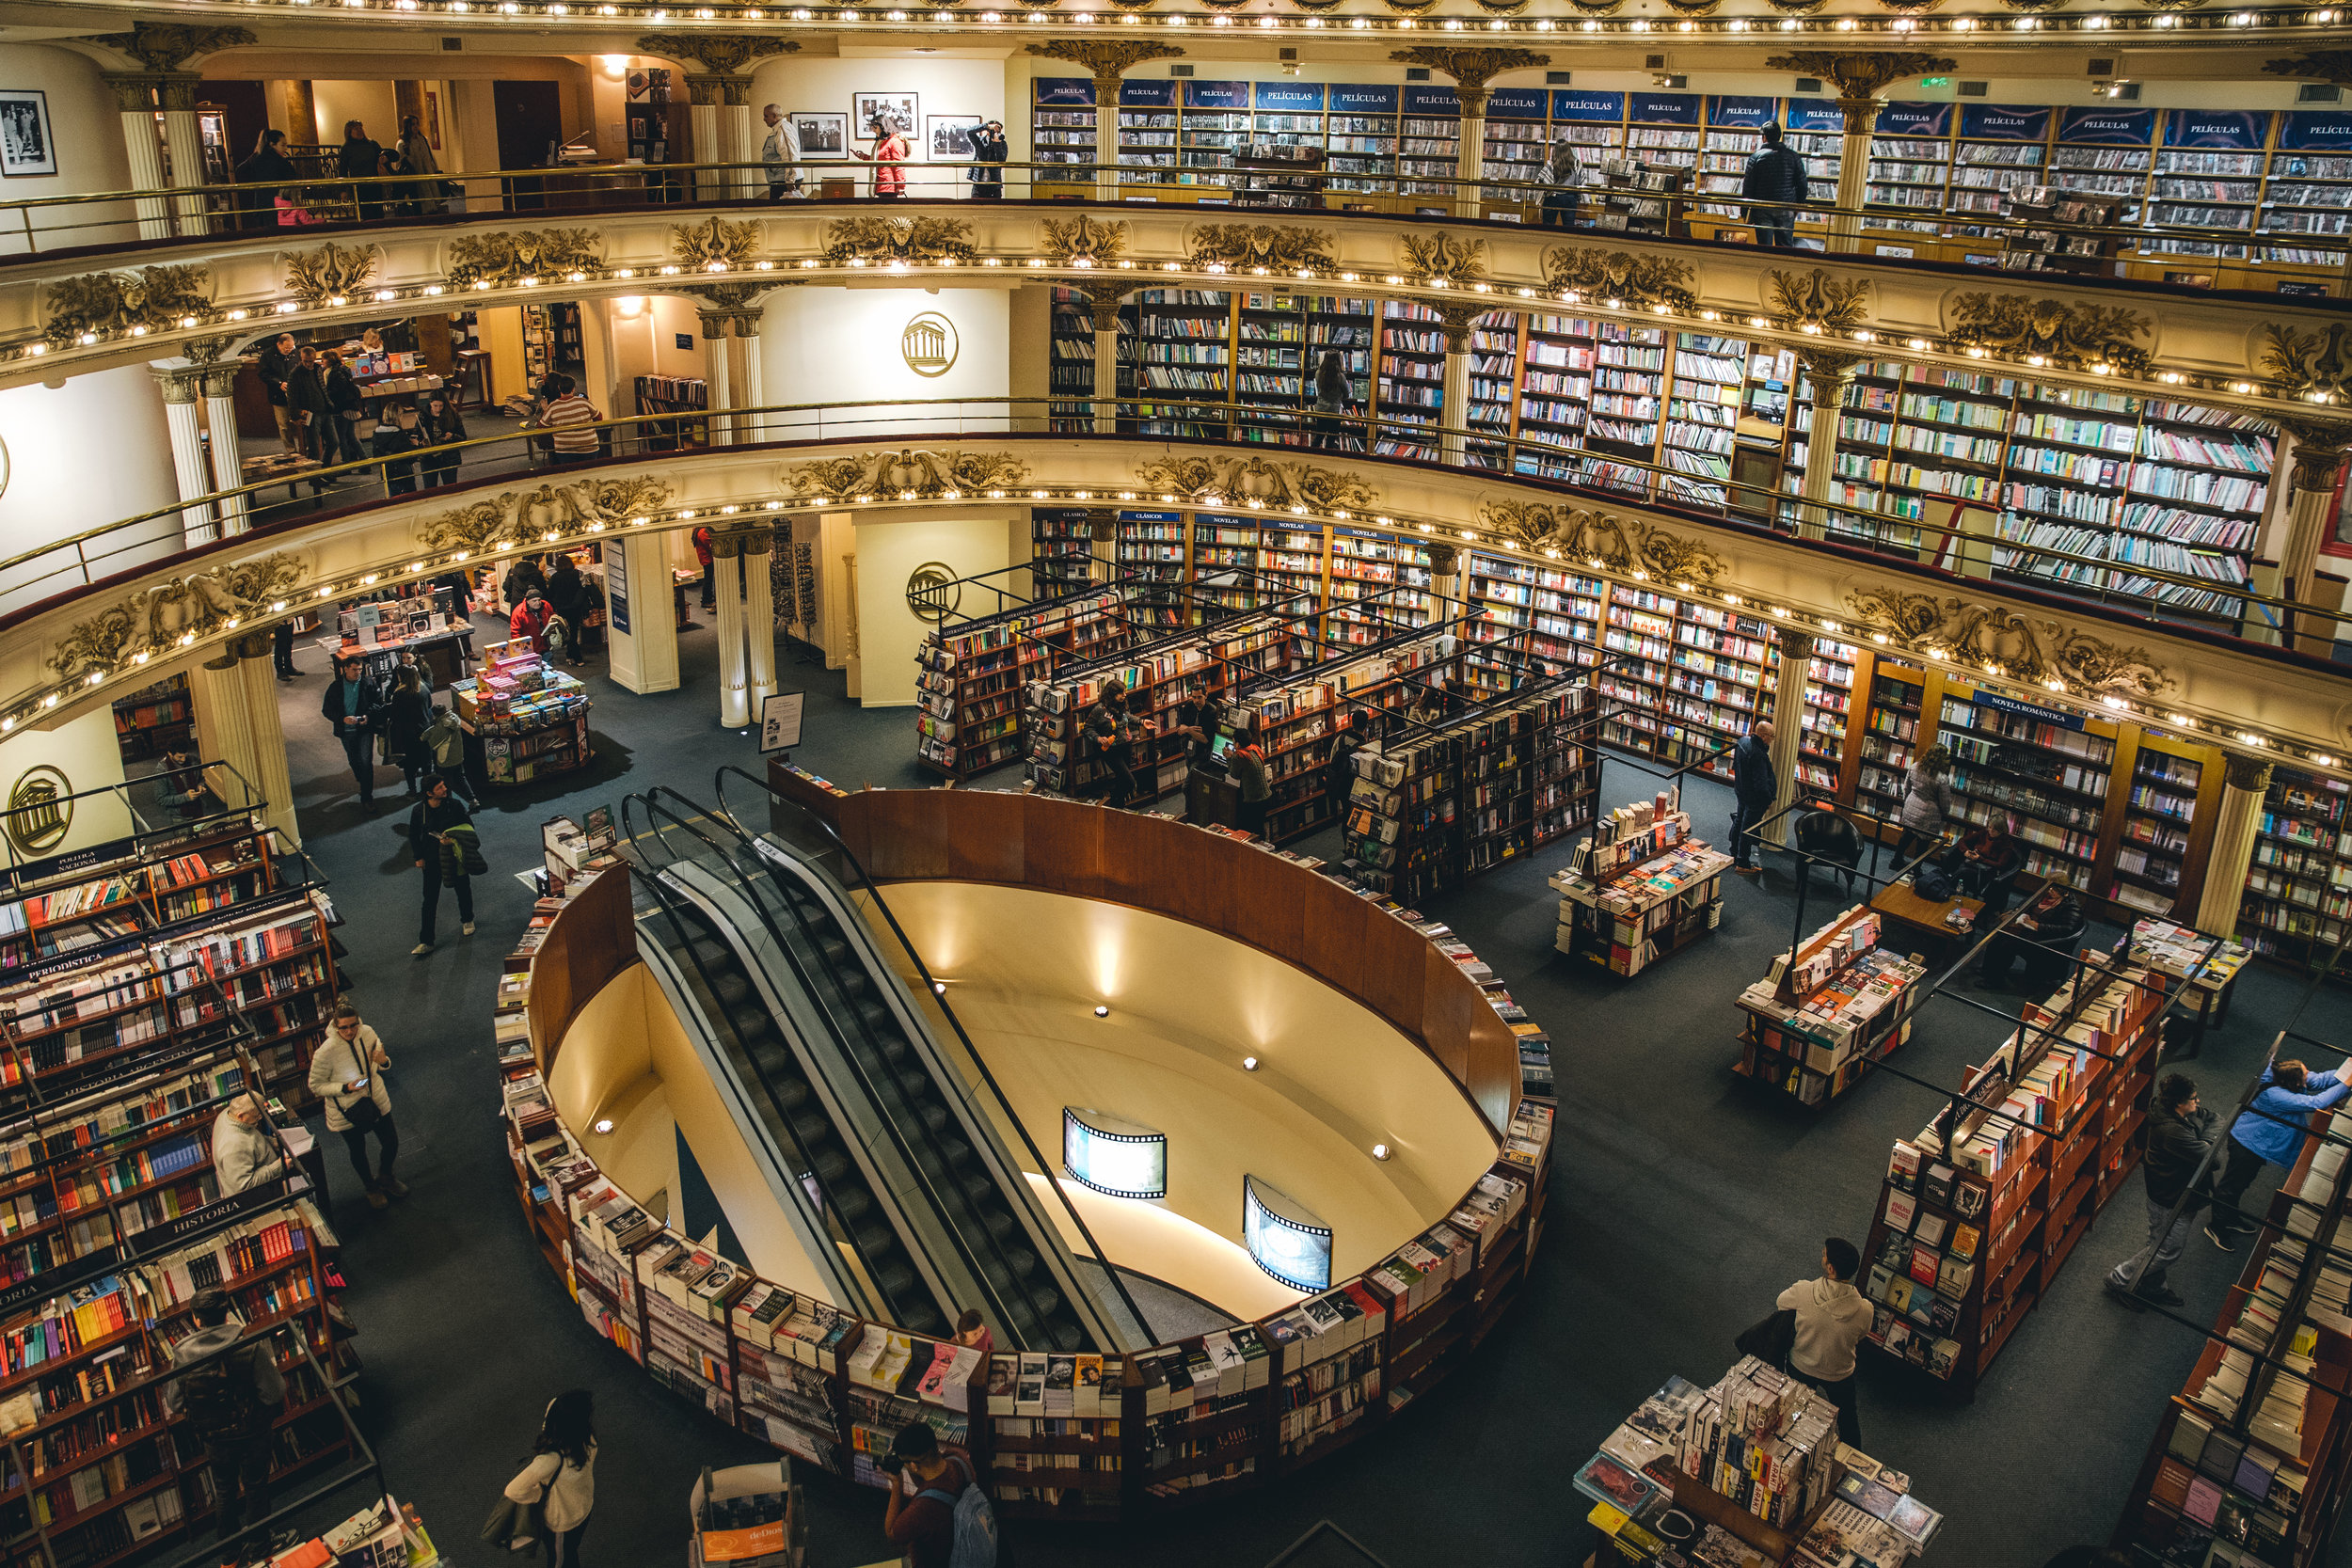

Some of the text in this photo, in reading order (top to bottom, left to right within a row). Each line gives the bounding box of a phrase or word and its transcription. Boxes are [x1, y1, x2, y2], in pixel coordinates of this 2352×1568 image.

[1266, 91, 1312, 101] PELÍCULAS
[1342, 93, 1387, 103] PELÍCULAS
[1416, 94, 1461, 104] PELÍCULAS
[1489, 98, 1536, 107] PELÍCULAS
[1565, 101, 1613, 110] PELÍCULAS
[1647, 103, 1681, 112] PELÍCULAS
[1726, 106, 1761, 116] PELÍCULAS
[1806, 109, 1843, 119] PELÍCULAS
[1891, 113, 1930, 122] PELÍCULAS
[1983, 117, 2026, 126] PELÍCULAS
[2084, 120, 2130, 130] PELÍCULAS
[2190, 124, 2240, 135] PELÍCULAS
[1352, 529, 1377, 537] NOVELAS
[1992, 696, 2066, 722] NOVELA ROMÁNTICA
[58, 858, 99, 872] NACIONAL
[29, 952, 103, 979] PERIODÍSTICA
[65, 1072, 123, 1097] HISTORIA
[173, 1200, 240, 1234] HISTORIA
[1769, 1461, 1780, 1488] ARAKI
[1752, 1486, 1763, 1515] ARAKI
[1820, 1546, 1843, 1561] NOW
